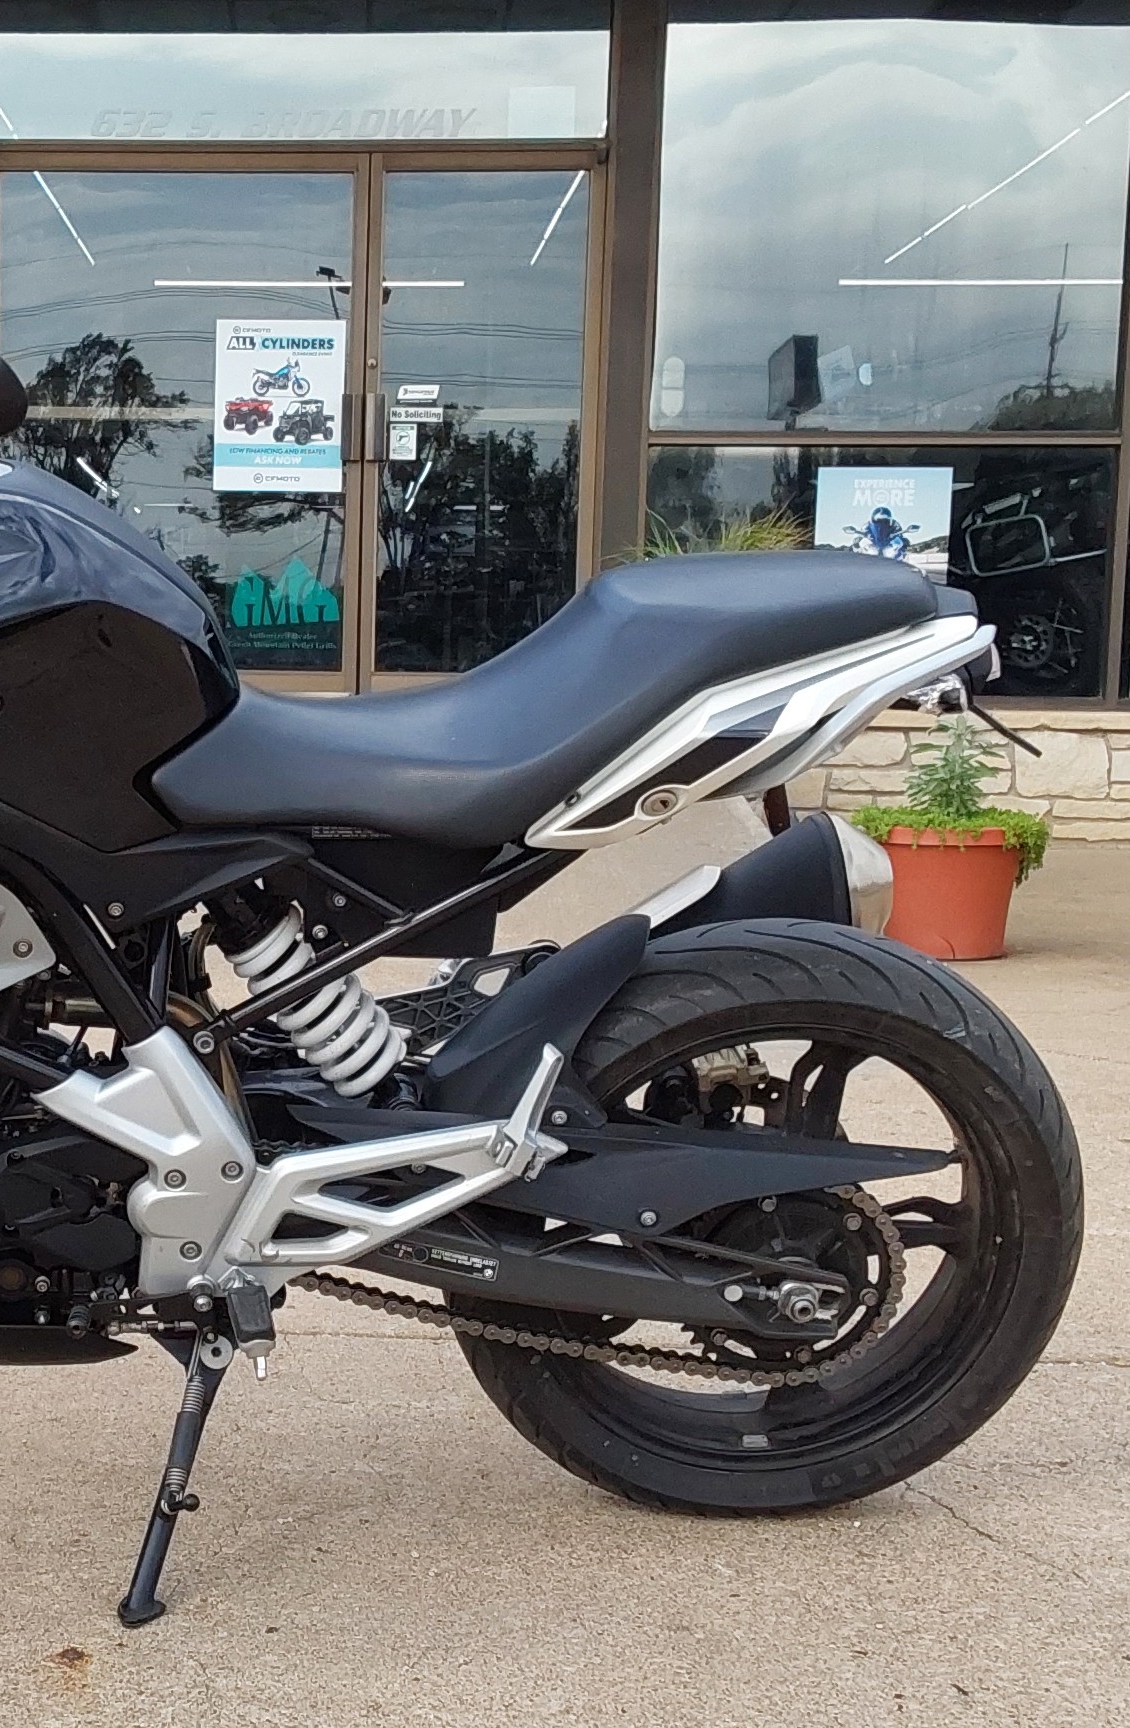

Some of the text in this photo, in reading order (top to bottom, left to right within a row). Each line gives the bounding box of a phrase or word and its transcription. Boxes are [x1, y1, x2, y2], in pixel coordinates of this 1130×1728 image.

[90, 107, 479, 138] 632 S. BROADWAY
[228, 336, 335, 350] ALL CYLINDERS
[391, 410, 442, 420] No Soliciting
[246, 447, 283, 455] FINANCING
[254, 456, 302, 465] ASK NOW
[854, 479, 916, 489] EXPERIENCE
[852, 489, 915, 506] MORE
